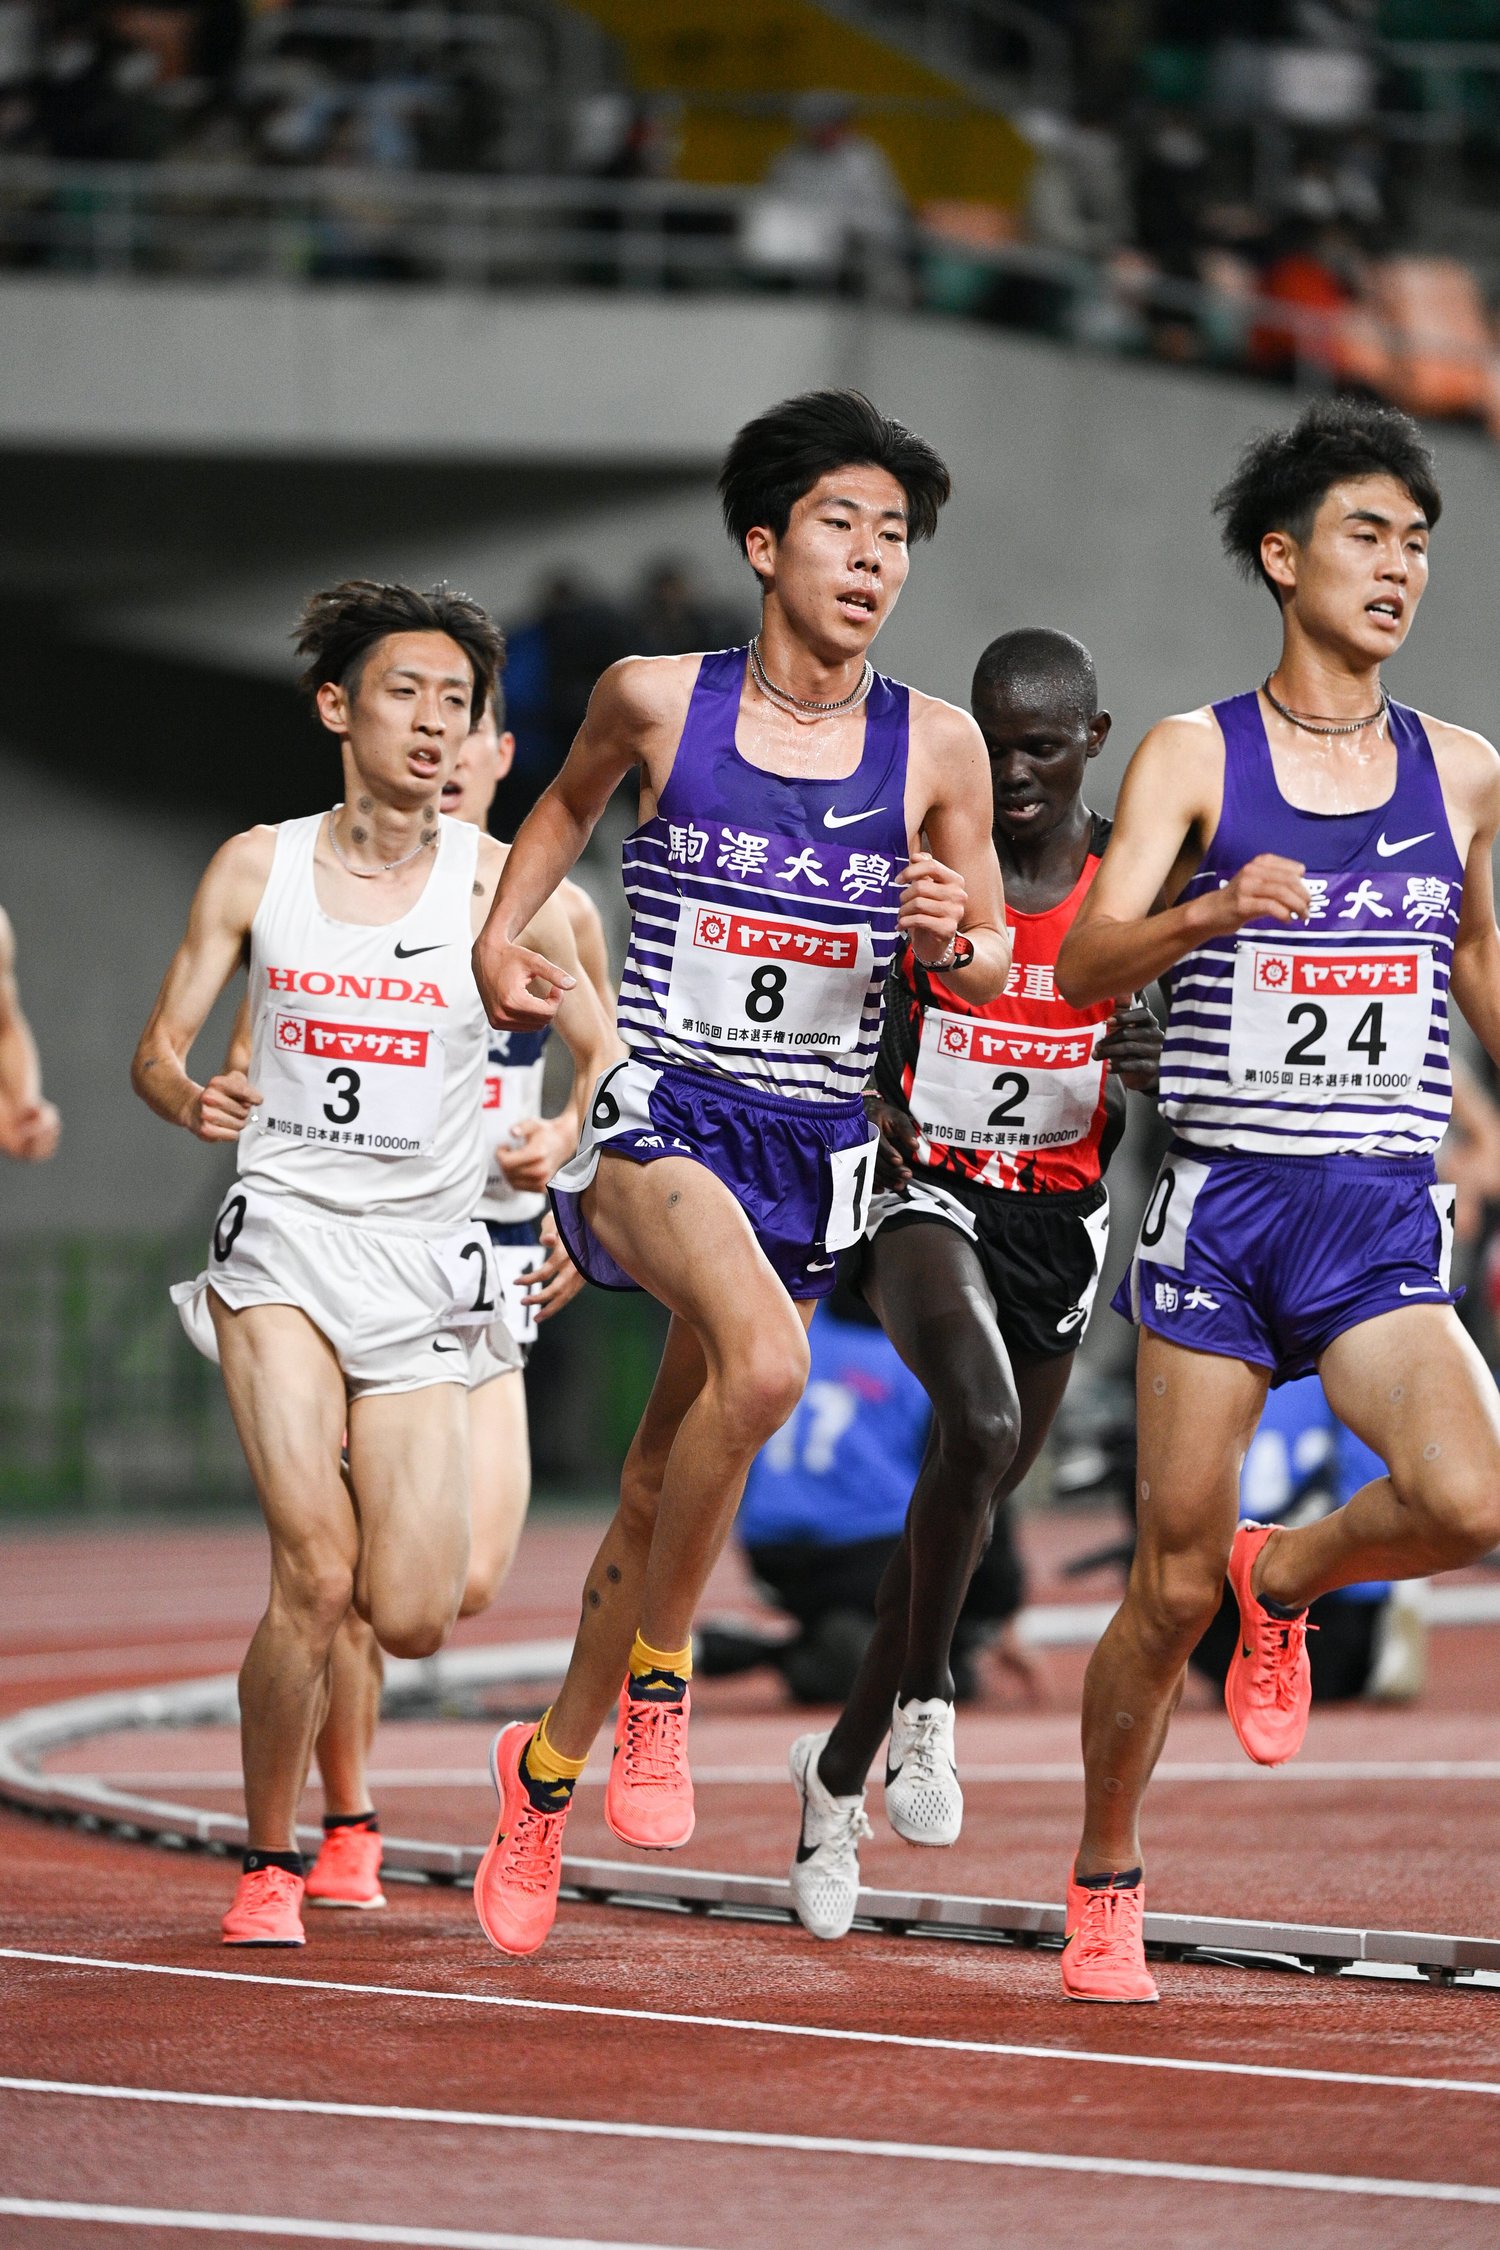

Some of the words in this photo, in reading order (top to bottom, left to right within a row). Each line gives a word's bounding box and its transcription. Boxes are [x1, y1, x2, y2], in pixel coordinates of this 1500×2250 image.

[667, 822, 892, 902] 駒澤大學
[737, 924, 851, 961] ヤマザキ
[266, 967, 449, 1009] HONDA
[745, 964, 788, 1023] 8
[1300, 962, 1412, 989] ヤマザキ
[311, 1027, 420, 1060] ヤマザキ
[682, 1018, 723, 1040] 第105回
[979, 1034, 1087, 1063] ヤマザキ
[1284, 1002, 1387, 1066] 24
[323, 1067, 361, 1125] 3
[591, 1061, 629, 1129] 6
[987, 1071, 1030, 1128] 2
[267, 1117, 303, 1137] 第105回
[922, 1122, 966, 1142] 第105回
[852, 1155, 869, 1232] 1
[1140, 1166, 1176, 1247] 0
[214, 1194, 247, 1263] 0
[459, 1241, 495, 1312] 2
[1155, 1282, 1221, 1312] 駒大
